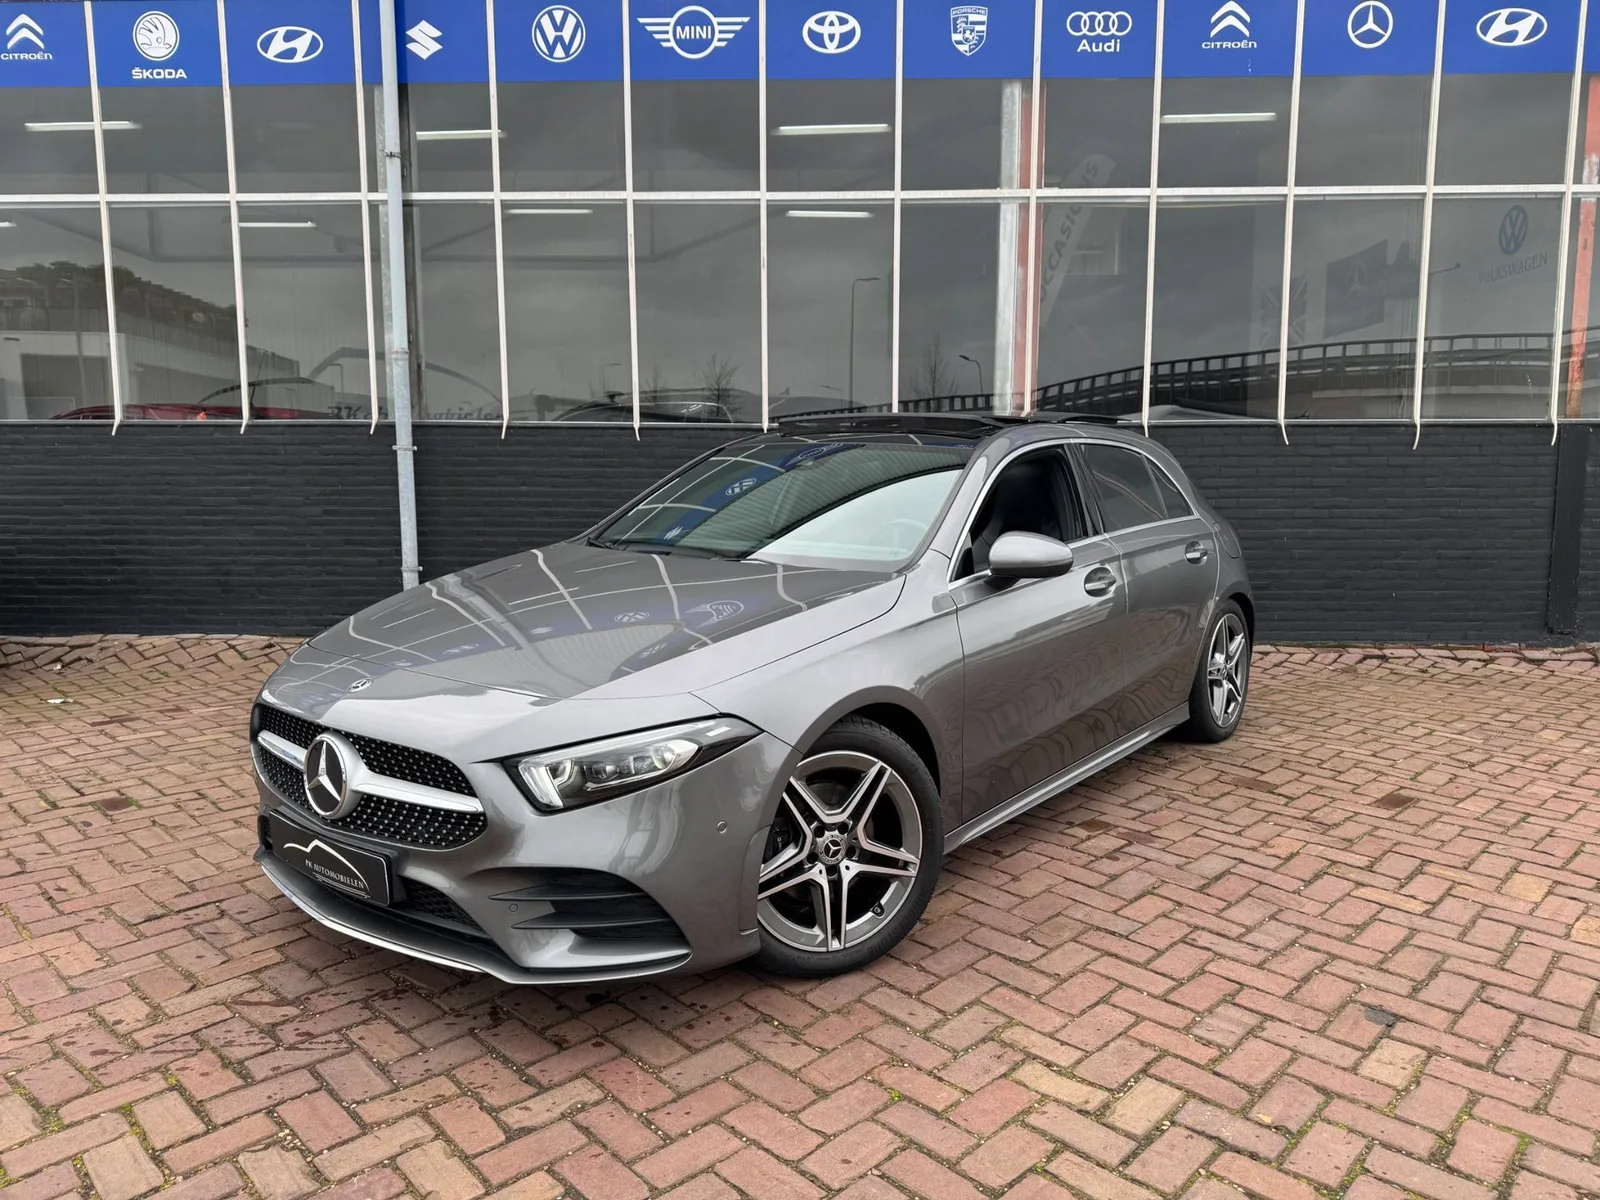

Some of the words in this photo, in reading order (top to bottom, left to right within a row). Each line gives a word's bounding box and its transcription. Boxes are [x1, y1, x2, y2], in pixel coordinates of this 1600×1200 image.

[676, 25, 711, 39] MINI
[1076, 38, 1121, 53] Audi
[131, 66, 188, 80] ŠKODA
[313, 863, 364, 889] AUTOMOBIELEN
